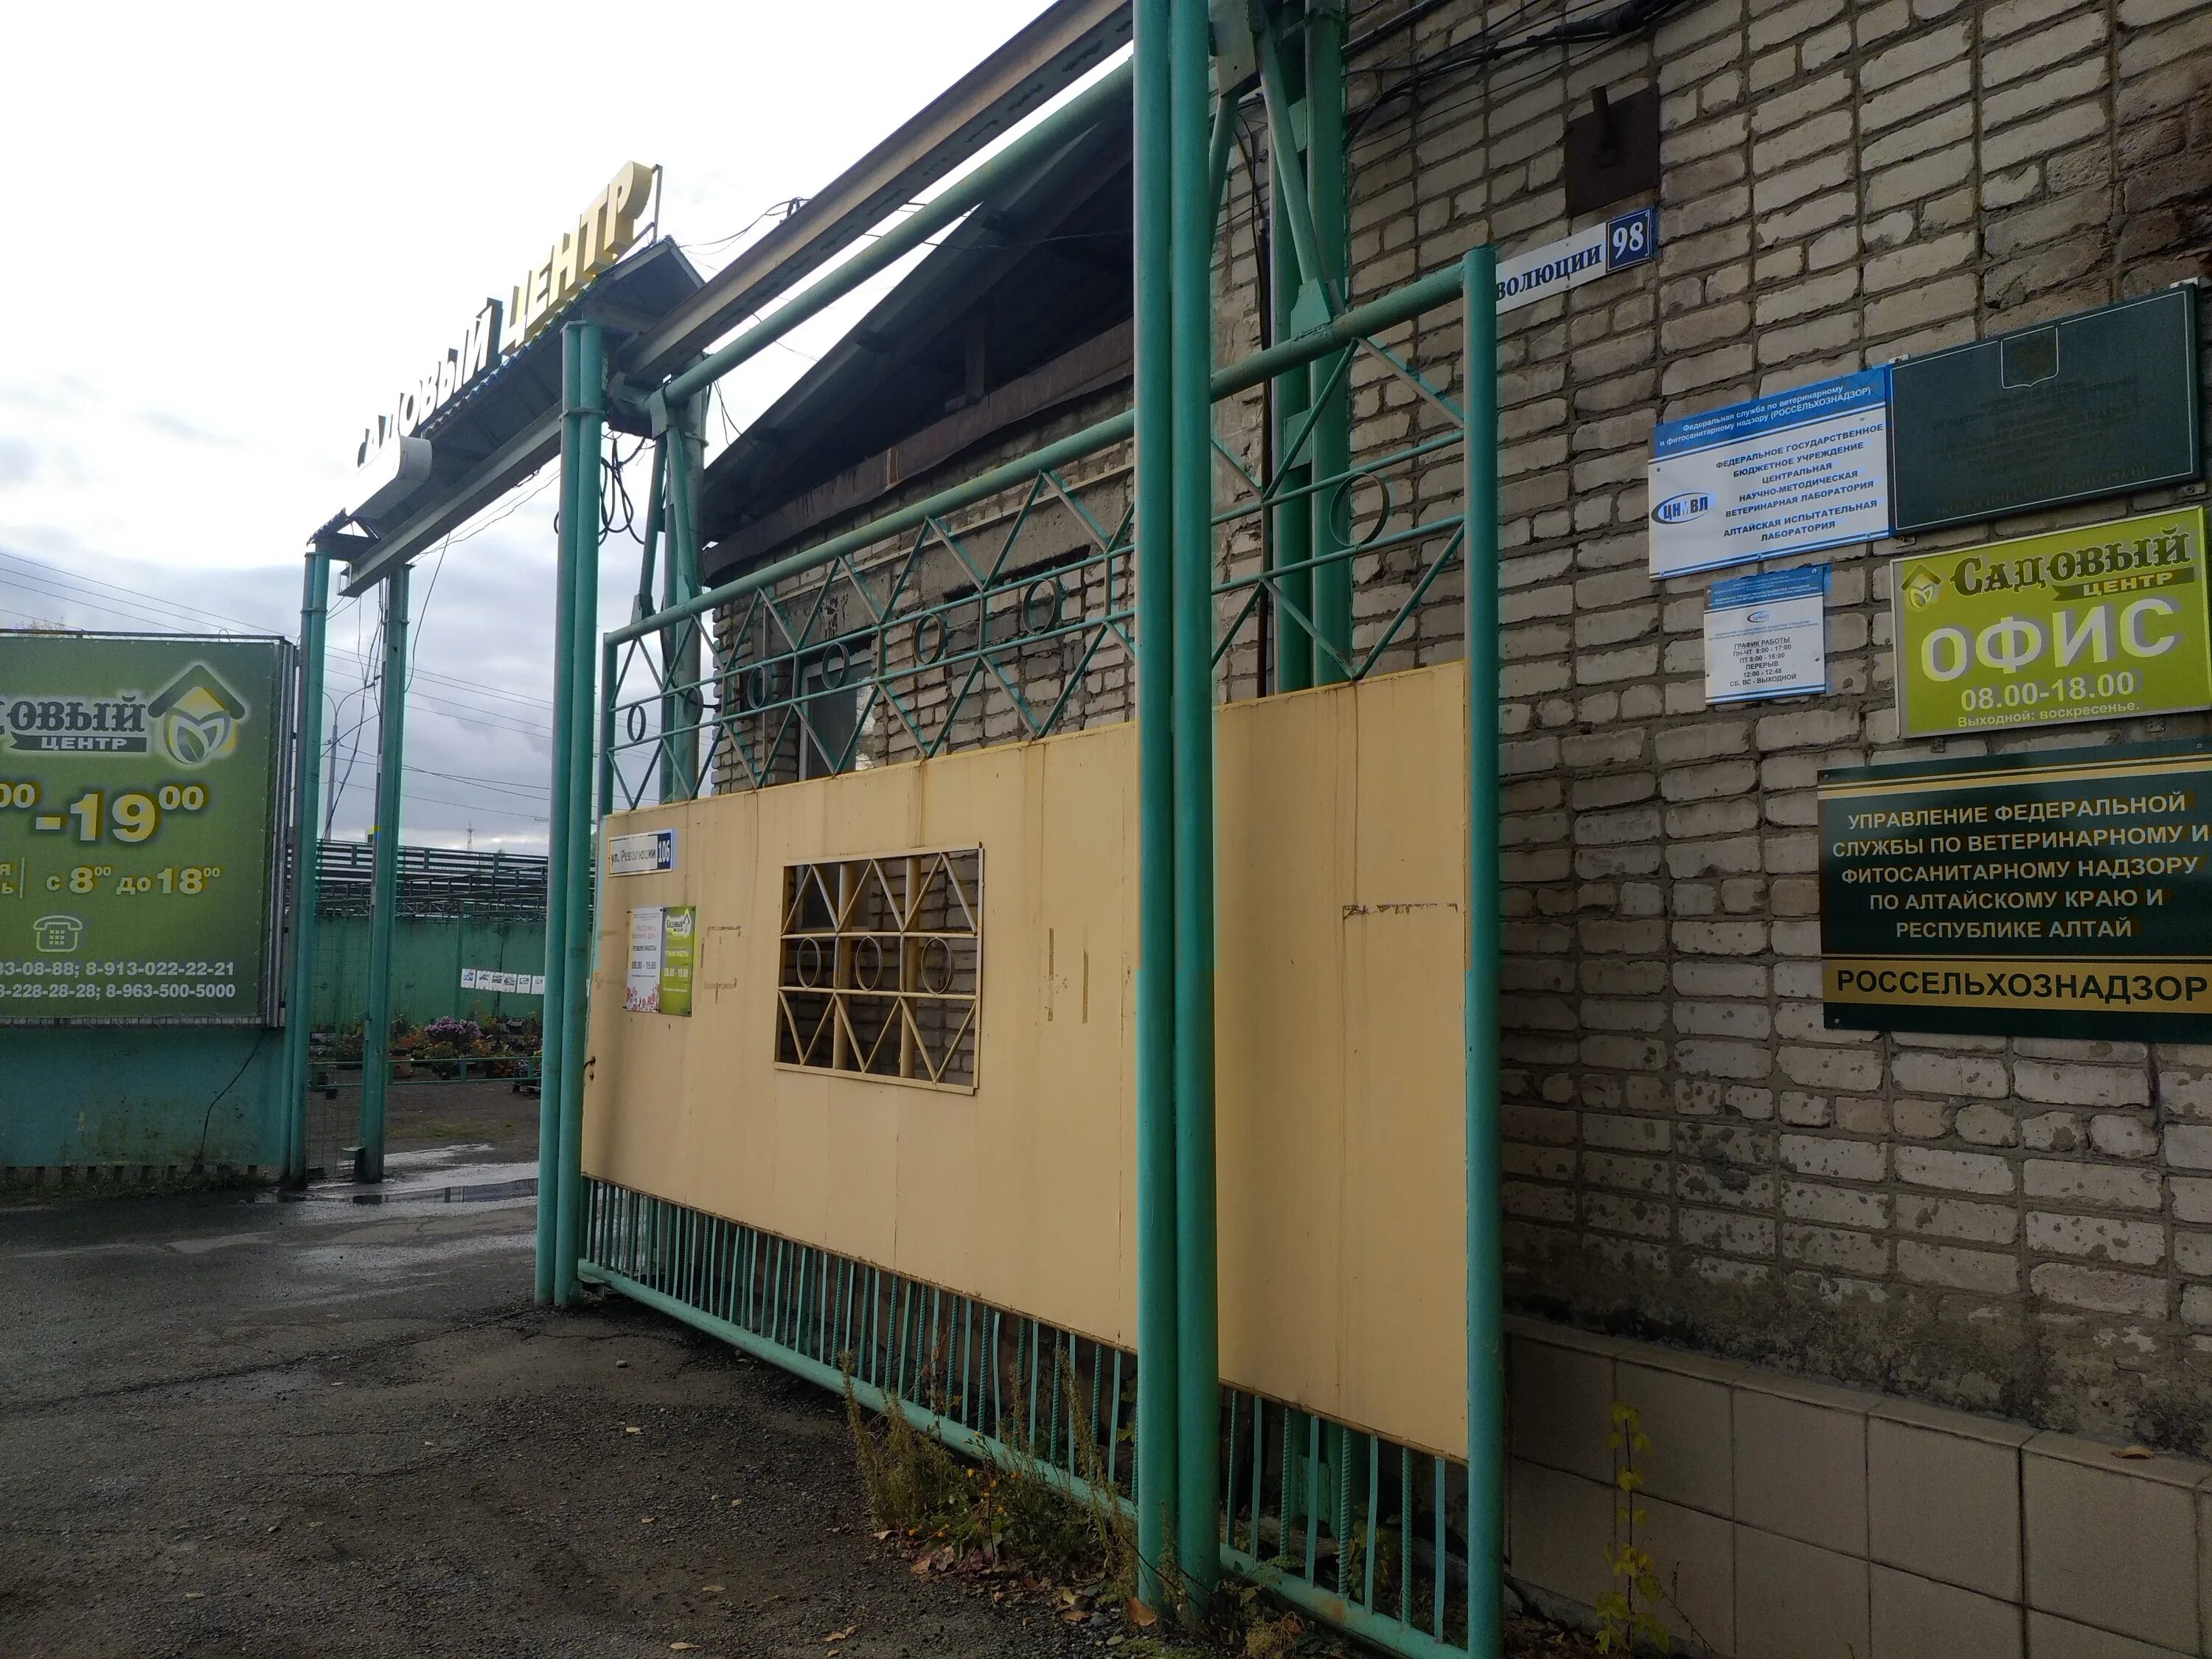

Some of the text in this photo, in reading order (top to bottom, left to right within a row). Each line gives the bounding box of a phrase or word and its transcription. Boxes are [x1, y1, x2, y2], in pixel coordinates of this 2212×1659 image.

[1613, 221, 1644, 259] 98
[498, 160, 653, 358] ЦЕНТР
[1666, 422, 1734, 448] фитосанитарному
[1736, 414, 1769, 430] надзору
[1770, 387, 1871, 420] (РОССЕЛЬХОЗНАДЗОР)
[1683, 386, 1843, 431] Федеральная служба по ветеринарному
[1716, 423, 1883, 470] ФЕДЕРАЛЬНОЕ ГОСУДАРСТВЕННОЕ
[1733, 442, 1864, 478] БЮДЖЕТНОЕ УЧРЕЖДЕНИЕ
[1739, 470, 1858, 502] НАУЧНО-МЕТОДИЧЕСКАЯ
[1762, 462, 1832, 484] ЦЕНТРАЛЬНАЯ
[1663, 495, 1708, 521] ЦНМВЛ
[1725, 480, 1874, 518] ВЕТЕРИНАРНАЯ ЛАБОРАТОРИЯ
[1723, 500, 1877, 537] АЛТАЙСКАЯ ИСПЫТАТЕЛЬНАЯ
[1761, 520, 1835, 542] ЛАБОРАТОРИЯ
[2084, 572, 2173, 597] ЦЕНТР
[1734, 637, 1790, 650] ГРАФИК РАБОТЫ
[1775, 644, 1792, 652] 17:00
[1921, 599, 2175, 682] ОФИС
[1746, 661, 1778, 669] ПЕРЕРЫВ
[1756, 672, 1797, 684] ВЫХОДНОЙ
[1961, 672, 2134, 712] 08.00-18.00
[0, 695, 146, 735] ОВЫЙ
[1958, 700, 2140, 728] Выходной: воскресенье.
[41, 737, 128, 751] ЦЕНТР
[1848, 791, 2185, 830] УПРАВЛЕНИЕ ФЕДЕРАЛЬНОЙ
[1833, 824, 2210, 858] СЛУЖБЫ ПО ВЕТЕРИНАРНОМУ И
[611, 854, 619, 866] ул.
[621, 849, 656, 862] Революции
[1841, 856, 2199, 884] ФИТОСАНИТАРНОМУ НАДЗОРУ
[116, 877, 151, 895] до
[1870, 888, 2164, 910] ПО АЛТАЙСКОМУ КРАЮ И
[1896, 917, 2132, 939] РЕСПУБЛИКЕ АЛТАЙ
[86, 961, 234, 976] 8-913-022-22-21
[106, 984, 236, 998] 8-963-500-5000
[1837, 969, 2208, 1005] РОССЕЛЬХОЗНАДЗОР
